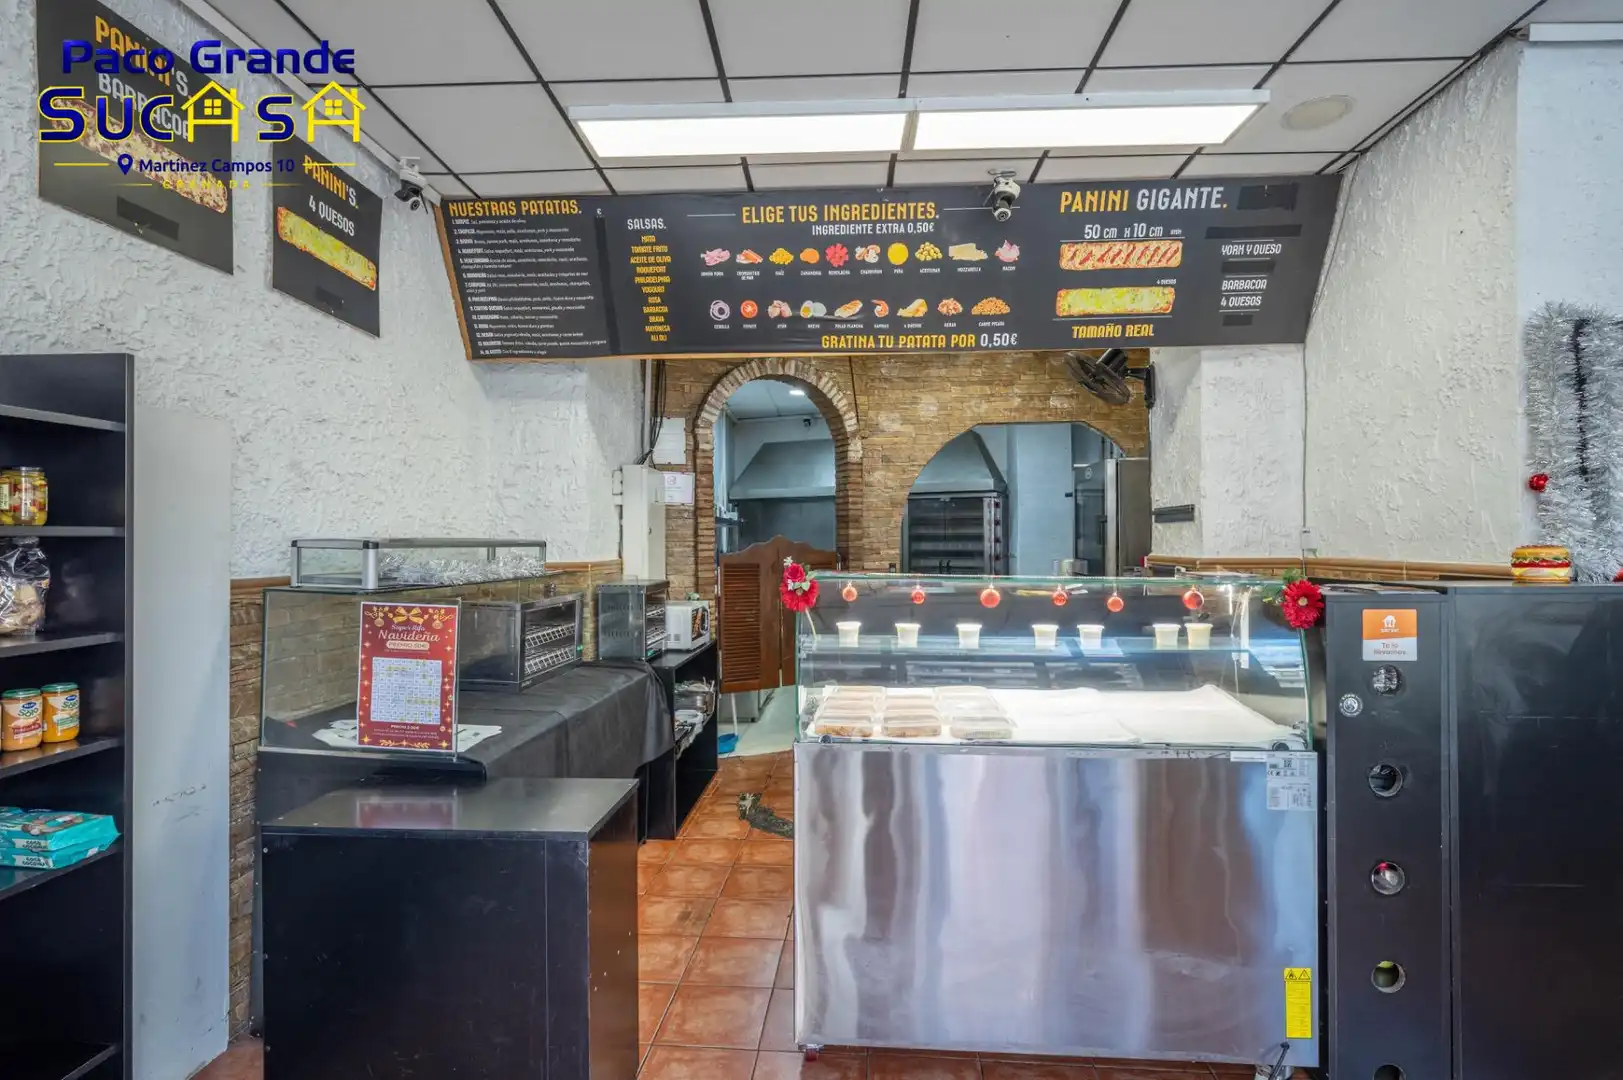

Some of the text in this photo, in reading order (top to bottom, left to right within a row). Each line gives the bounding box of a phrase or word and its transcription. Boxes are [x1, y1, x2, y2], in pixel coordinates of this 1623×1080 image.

[1060, 187, 1228, 213] PANINI GIGANTE.
[308, 195, 355, 237] 4 QUESOS
[449, 200, 582, 217] NUESTRAS PATATAS.
[742, 202, 940, 223] ELIGE TUS INGREDIENTES.
[627, 218, 667, 230] SALSAS.
[812, 223, 873, 236] INGREDIENTE
[876, 222, 905, 235] EXTRA
[1084, 224, 1101, 239] 50
[1133, 222, 1146, 238] 10
[1246, 244, 1252, 255] Y
[1253, 243, 1282, 255] QUESO
[1221, 279, 1268, 290] BARBACOA
[1220, 296, 1262, 307] 4 QUESOS
[1072, 323, 1154, 339] TAMAÑO REAL
[821, 333, 1018, 349] GRATINA TU PATATA POR 0,50€
[378, 629, 441, 642] Navideña
